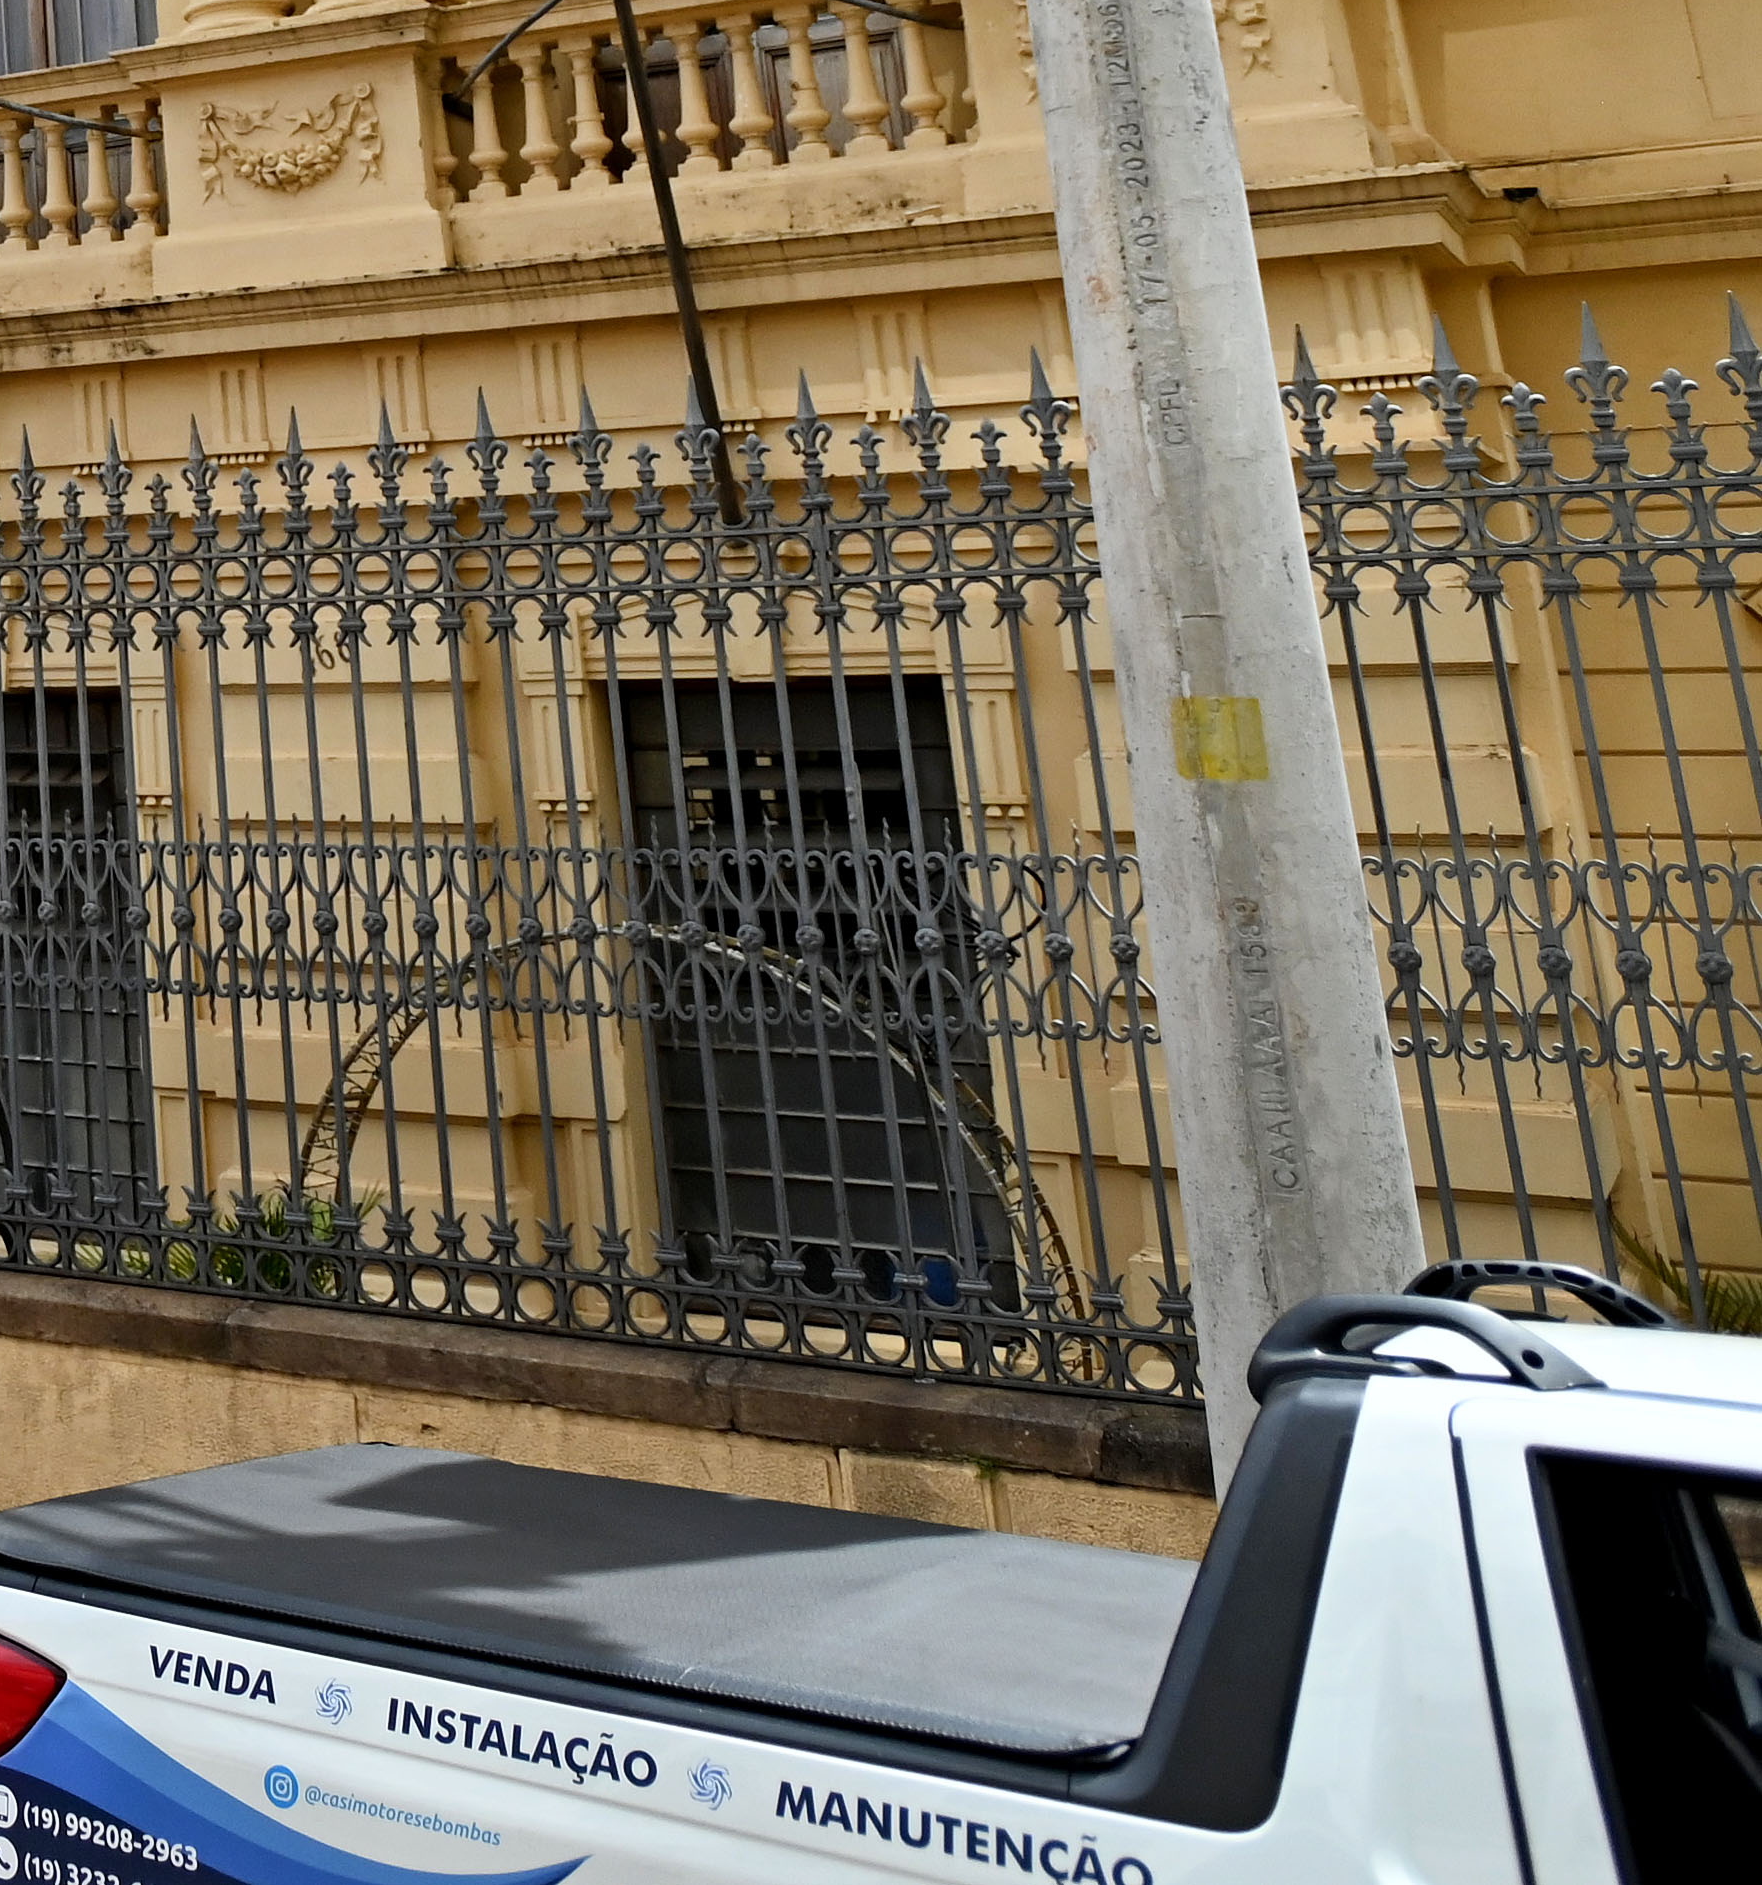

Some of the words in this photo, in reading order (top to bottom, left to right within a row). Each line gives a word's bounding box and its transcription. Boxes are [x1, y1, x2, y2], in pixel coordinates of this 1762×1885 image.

[150, 1645, 277, 1704] VENDA
[387, 1697, 658, 1788] INSTALAÇÃO
[23, 1801, 60, 1837] (19)
[65, 1812, 198, 1871] 99208-2963
[304, 1785, 501, 1846] @casimotoresebombas
[775, 1780, 1153, 1885] MANUTENÇÃO
[24, 1852, 61, 1885] (19)
